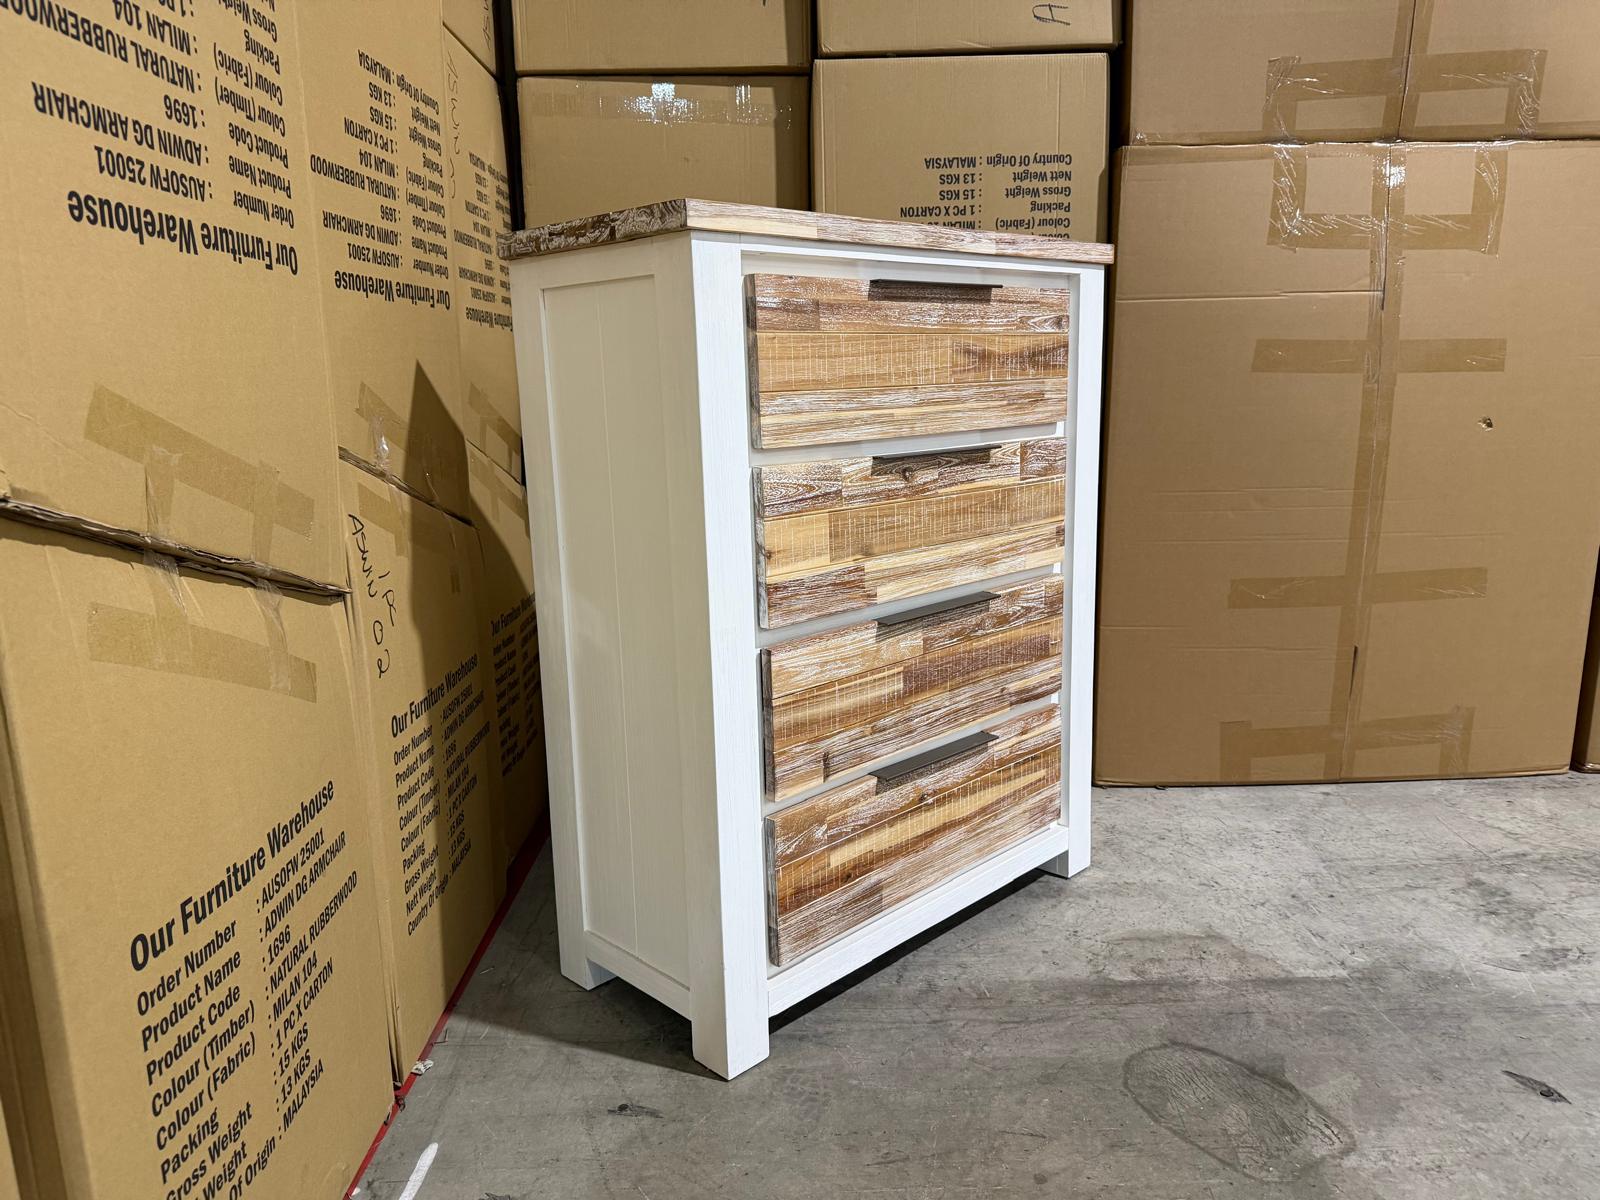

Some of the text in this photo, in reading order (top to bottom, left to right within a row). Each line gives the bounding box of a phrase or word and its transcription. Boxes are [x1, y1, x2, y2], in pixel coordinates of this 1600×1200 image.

[252, 8, 278, 44] Gross
[112, 0, 283, 107] Colour (Fabric) MILAN 104
[129, 40, 196, 94] NATURAL
[243, 28, 281, 76] Packing
[214, 76, 256, 124] (Timber)
[358, 49, 440, 116] Country Of Origin MALAYSIA
[163, 94, 289, 170] Product Code 1696
[257, 105, 286, 138] Colour
[344, 116, 374, 146] CARTON
[368, 81, 441, 137] Nett Weight 13 KGS
[369, 106, 442, 157] Gross Weight 15 KGS
[31, 81, 292, 200] Product Name ADWIN DG ARMCHAIR
[358, 148, 373, 170] 104
[374, 130, 379, 149] X
[379, 134, 389, 153] PC
[389, 138, 394, 155] 1
[924, 152, 1073, 170] Country Of Origin MALAYSIA
[94, 145, 295, 230] Order Number AUSOFW 25001
[310, 154, 446, 219] Colour (Timber) NATURAL RUBBERWOOD
[374, 154, 396, 179] MILAN
[406, 166, 428, 192] (Fabric)
[422, 152, 444, 179] Packing
[428, 179, 445, 199] Colour
[939, 169, 1072, 185] Nett Weight 13 KGS
[900, 200, 1071, 218] Packing 1 PC X CARTON
[938, 185, 1072, 202] Gross Weight 15 KGS
[67, 190, 298, 276] Our Furniture Warehouse
[322, 210, 448, 260] Product Name ADWIN DG ARMCHAIR
[380, 204, 447, 240] Product Code 1696
[995, 216, 1036, 231] (Fabric)
[1036, 217, 1071, 229] Colour
[347, 242, 449, 280] Order Number AUSOFW 25001
[334, 270, 451, 311] Our Furniture Warehouse
[391, 653, 478, 738] Our Furniture Warehouse
[394, 724, 433, 766] Order Number
[395, 744, 435, 789] Product Name
[397, 765, 435, 811] Product Code
[399, 778, 441, 832] Colour (Timber)
[400, 798, 441, 853] Colour (Fabric)
[130, 780, 334, 972] Our Furniture Warehouse
[402, 839, 426, 875] Packing
[404, 844, 439, 896] Gross Weight
[406, 867, 437, 917] Nett Weight
[137, 827, 325, 1017] Order Number AUSOFW 25001
[141, 830, 346, 1053] Product Name ADWIN DG ARMCHAIR
[146, 924, 291, 1087] Product Code 1696
[152, 870, 358, 1118] Colour (Timber) NATURAL RUBBERWOOD
[156, 950, 318, 1151] Colour (Fabric) MILAN 104
[160, 956, 334, 1185] Packing 1 PC X CARTON
[166, 1022, 309, 1200] Gross Weight 15 KGS
[202, 1048, 311, 1200] Weight 13 KGS
[244, 1136, 276, 1186] Origin
[282, 1058, 324, 1133] MALAYSIA
